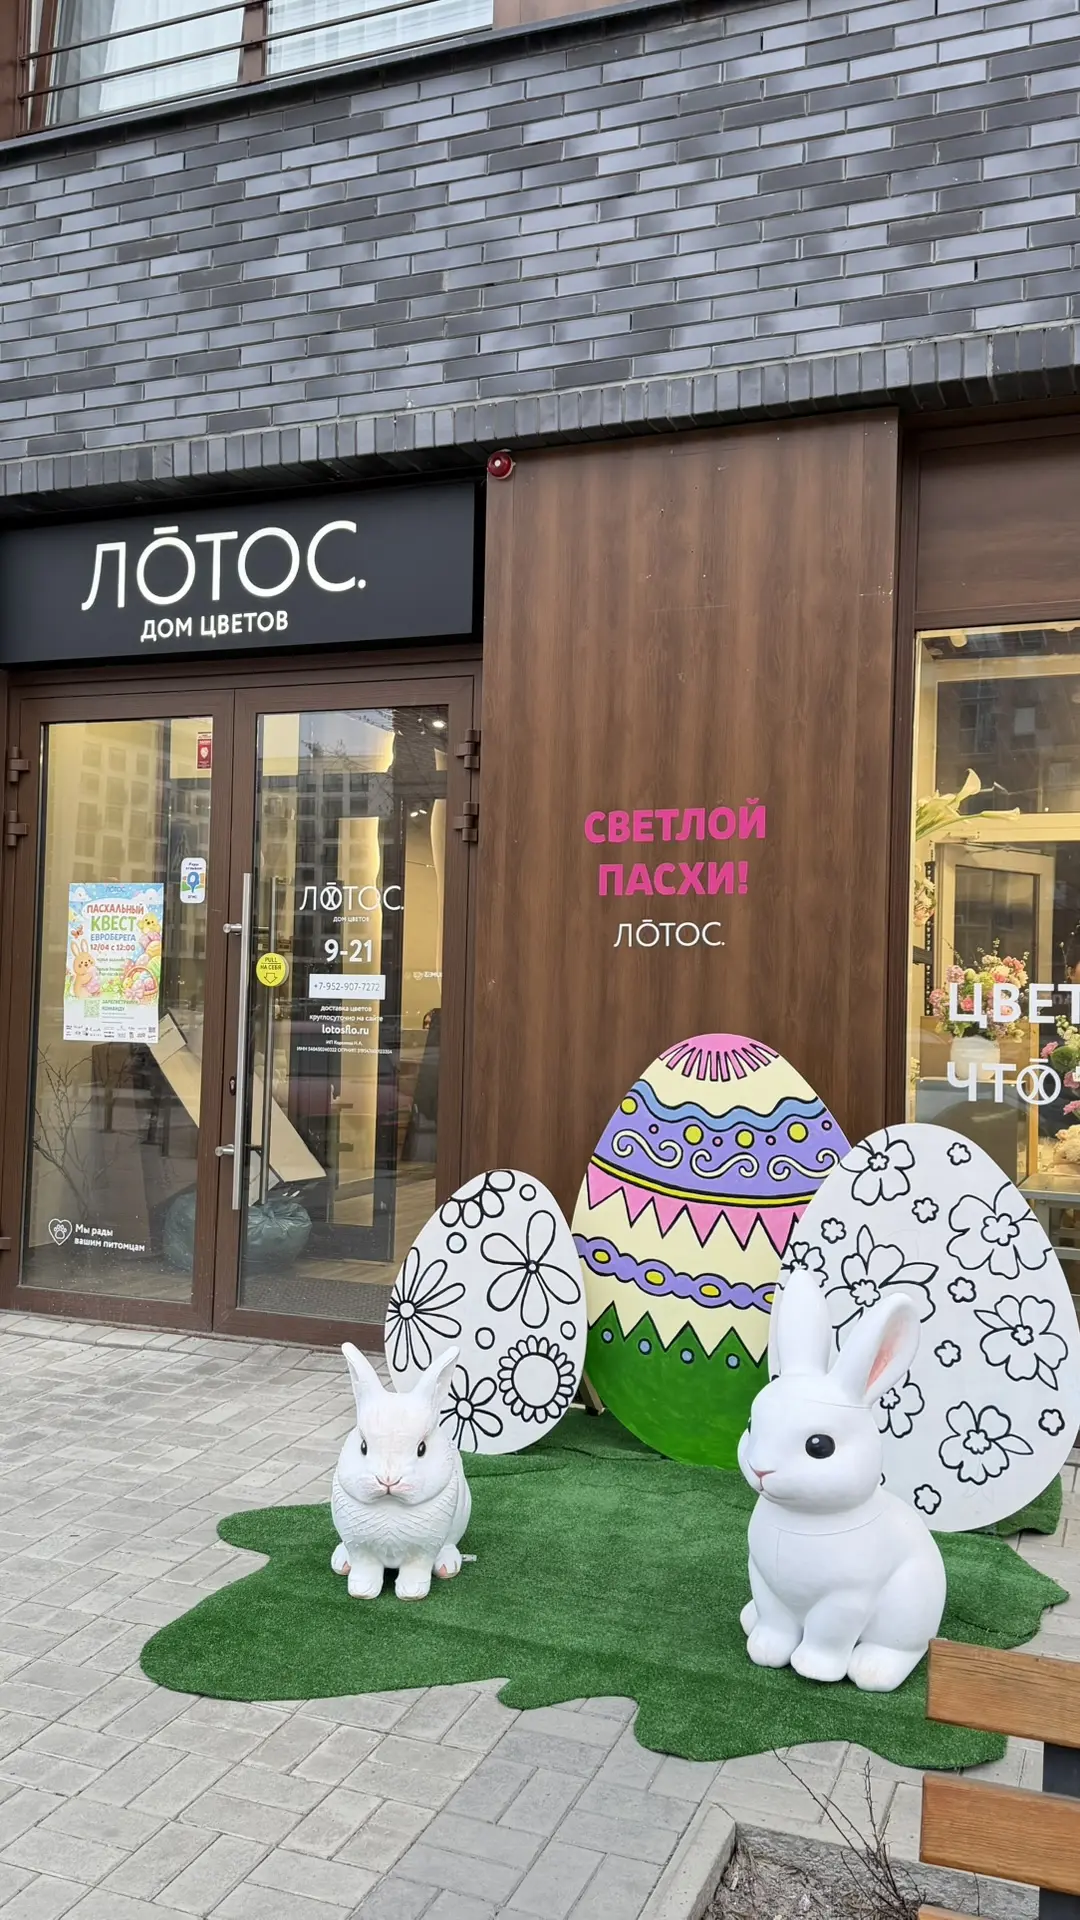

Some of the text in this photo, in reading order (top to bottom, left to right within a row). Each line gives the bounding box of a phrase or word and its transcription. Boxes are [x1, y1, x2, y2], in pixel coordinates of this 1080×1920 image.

[140, 610, 289, 643] ДОМ ЦВЕТОВ
[584, 797, 767, 844] СВЕТЛОЙ
[598, 860, 749, 897] ПАСХИ!
[86, 903, 144, 915] ПАСХАЛЬНЫЙ
[91, 915, 137, 931] КВЕСТ
[90, 933, 137, 942] ЕВРОБЕРЕГА
[90, 943, 110, 952] 12/04
[324, 938, 372, 962] 9-21
[313, 982, 381, 992] +7-952-907-7272
[309, 1014, 356, 1022] круглосуточно
[365, 1014, 384, 1022] сайте
[321, 1024, 369, 1035] lotosflo.ru
[75, 1223, 113, 1236] Мы рады
[74, 1237, 145, 1252] вашим питомцам
